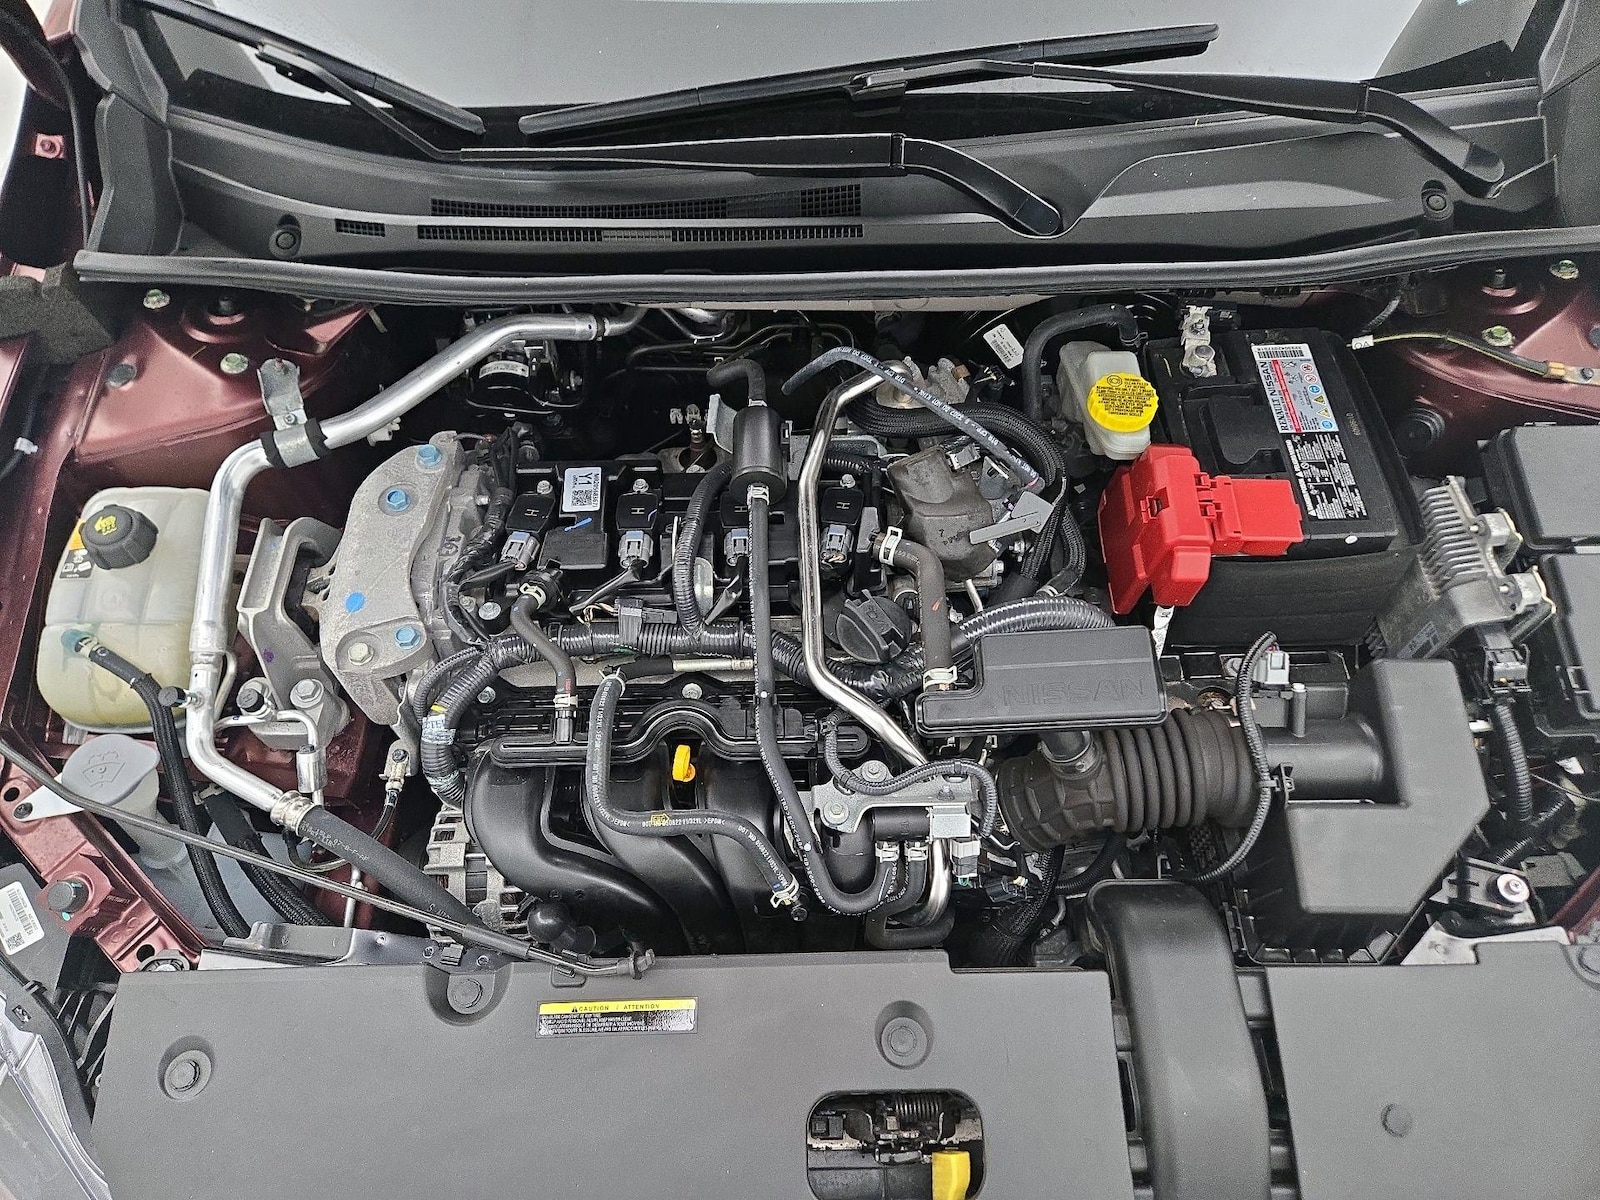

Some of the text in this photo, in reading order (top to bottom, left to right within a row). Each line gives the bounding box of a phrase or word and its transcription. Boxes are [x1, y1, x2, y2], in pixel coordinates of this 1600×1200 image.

[1259, 361, 1277, 397] NISSAN
[579, 472, 593, 485] Y1
[1001, 677, 1145, 706] NISSAN
